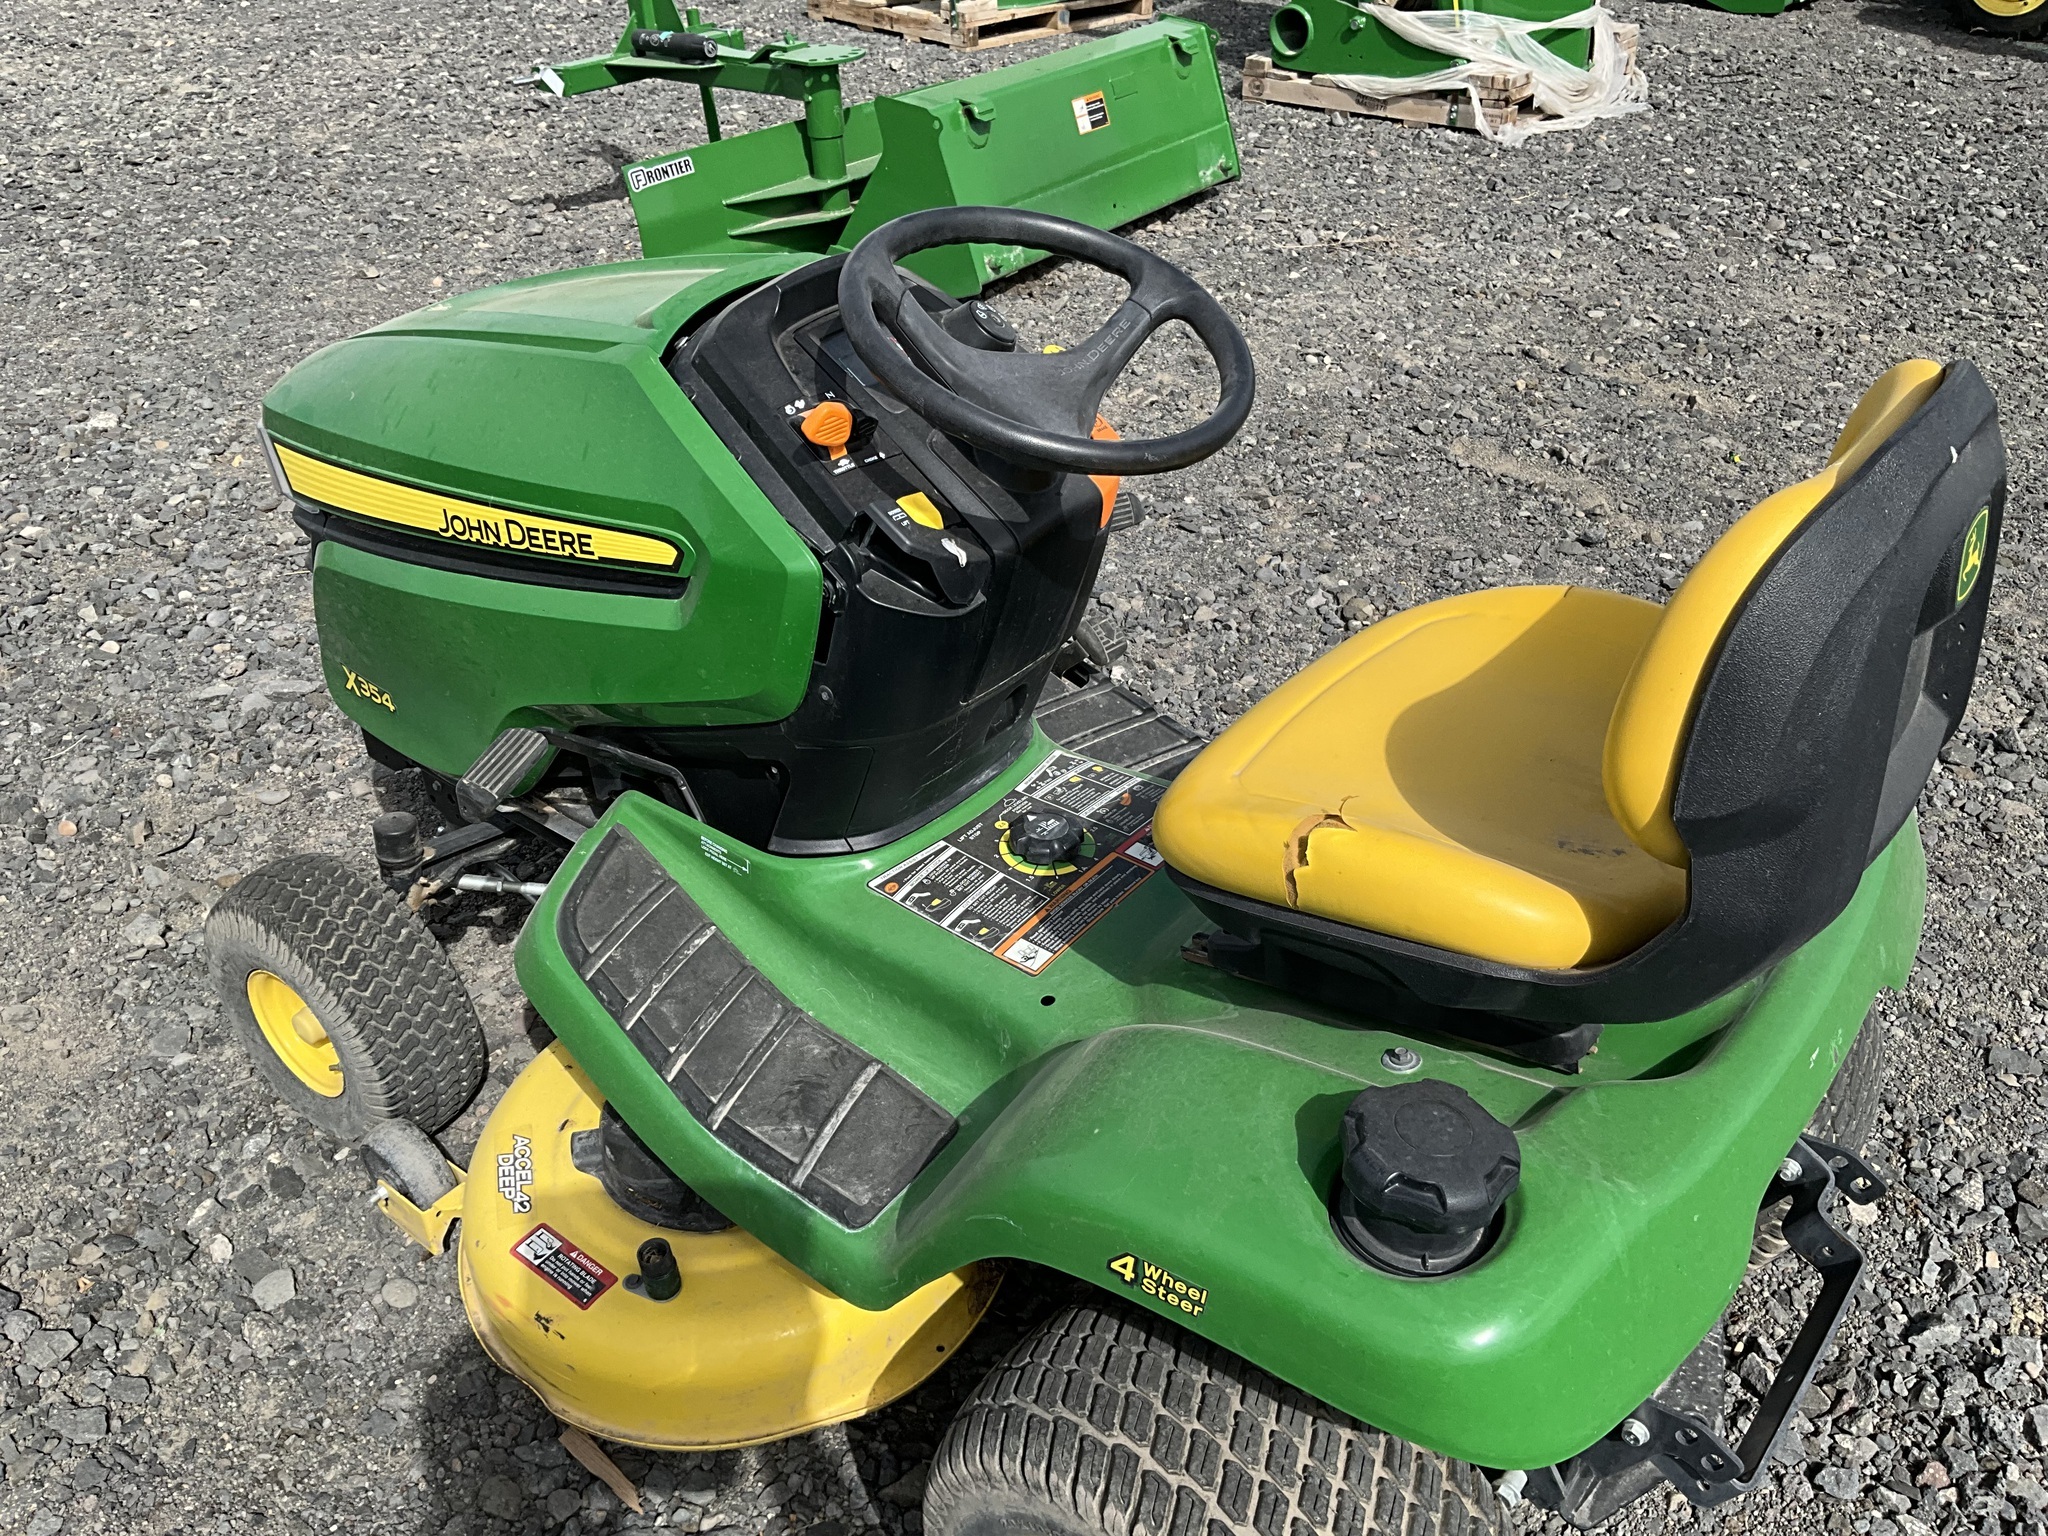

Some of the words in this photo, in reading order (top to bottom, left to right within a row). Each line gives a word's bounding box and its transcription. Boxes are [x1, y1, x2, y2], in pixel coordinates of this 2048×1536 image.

[630, 159, 693, 190] FRONTIER
[1090, 319, 1131, 361] DEERE
[438, 508, 506, 542] JOHN
[505, 519, 595, 556] DEERE
[342, 664, 397, 713] X354
[496, 1153, 516, 1201] DEEP
[513, 1134, 532, 1191] ACCEL
[512, 1190, 531, 1213] 42
[557, 1254, 581, 1272] ROTATING
[579, 1270, 596, 1284] BLADE
[576, 1254, 603, 1275] DANGER
[1109, 1254, 1136, 1283] 4
[1143, 1261, 1208, 1305] Wheel
[1141, 1277, 1203, 1317] Steer
